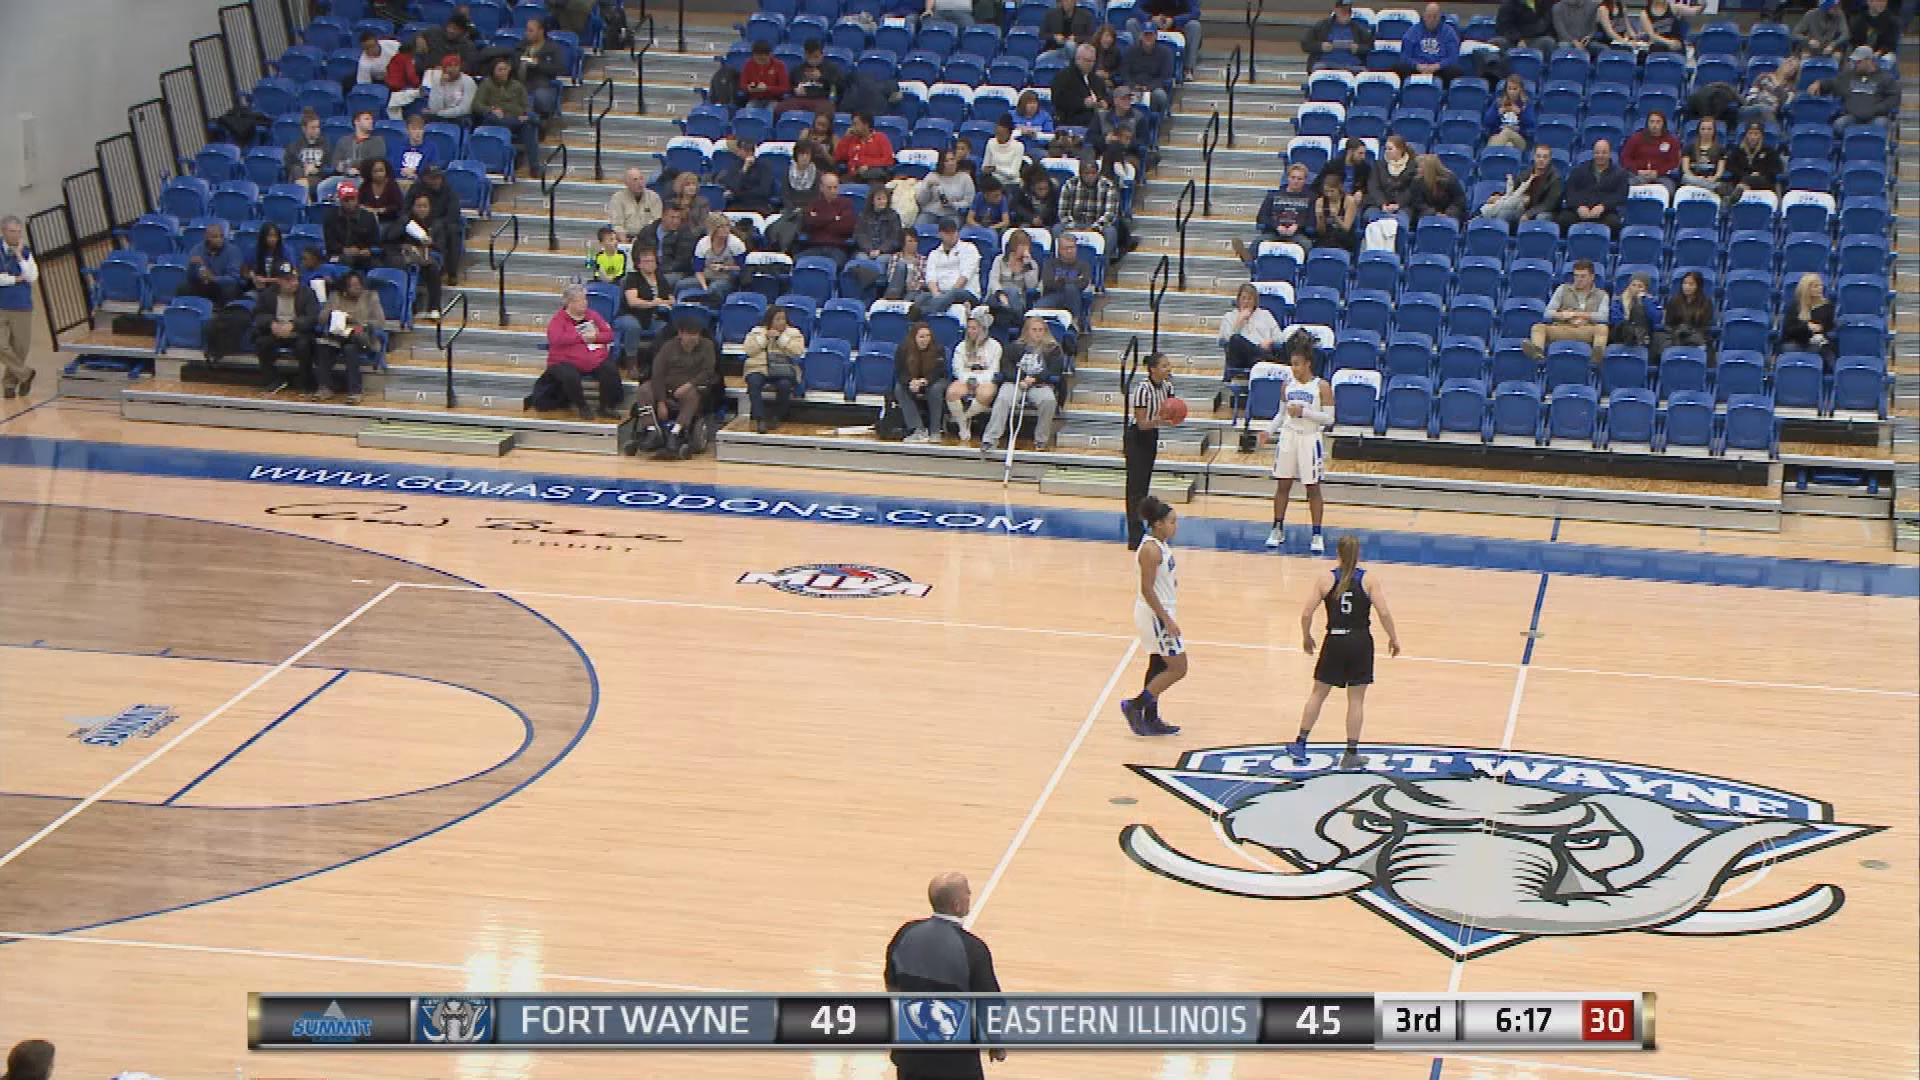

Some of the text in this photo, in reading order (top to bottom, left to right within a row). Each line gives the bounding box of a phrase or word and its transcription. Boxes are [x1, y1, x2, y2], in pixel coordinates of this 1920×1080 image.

[249, 464, 1044, 533] WWW.GOMASTODONS.COM
[1340, 591, 1353, 614] 5
[1221, 752, 1790, 819] FORT WAYNE
